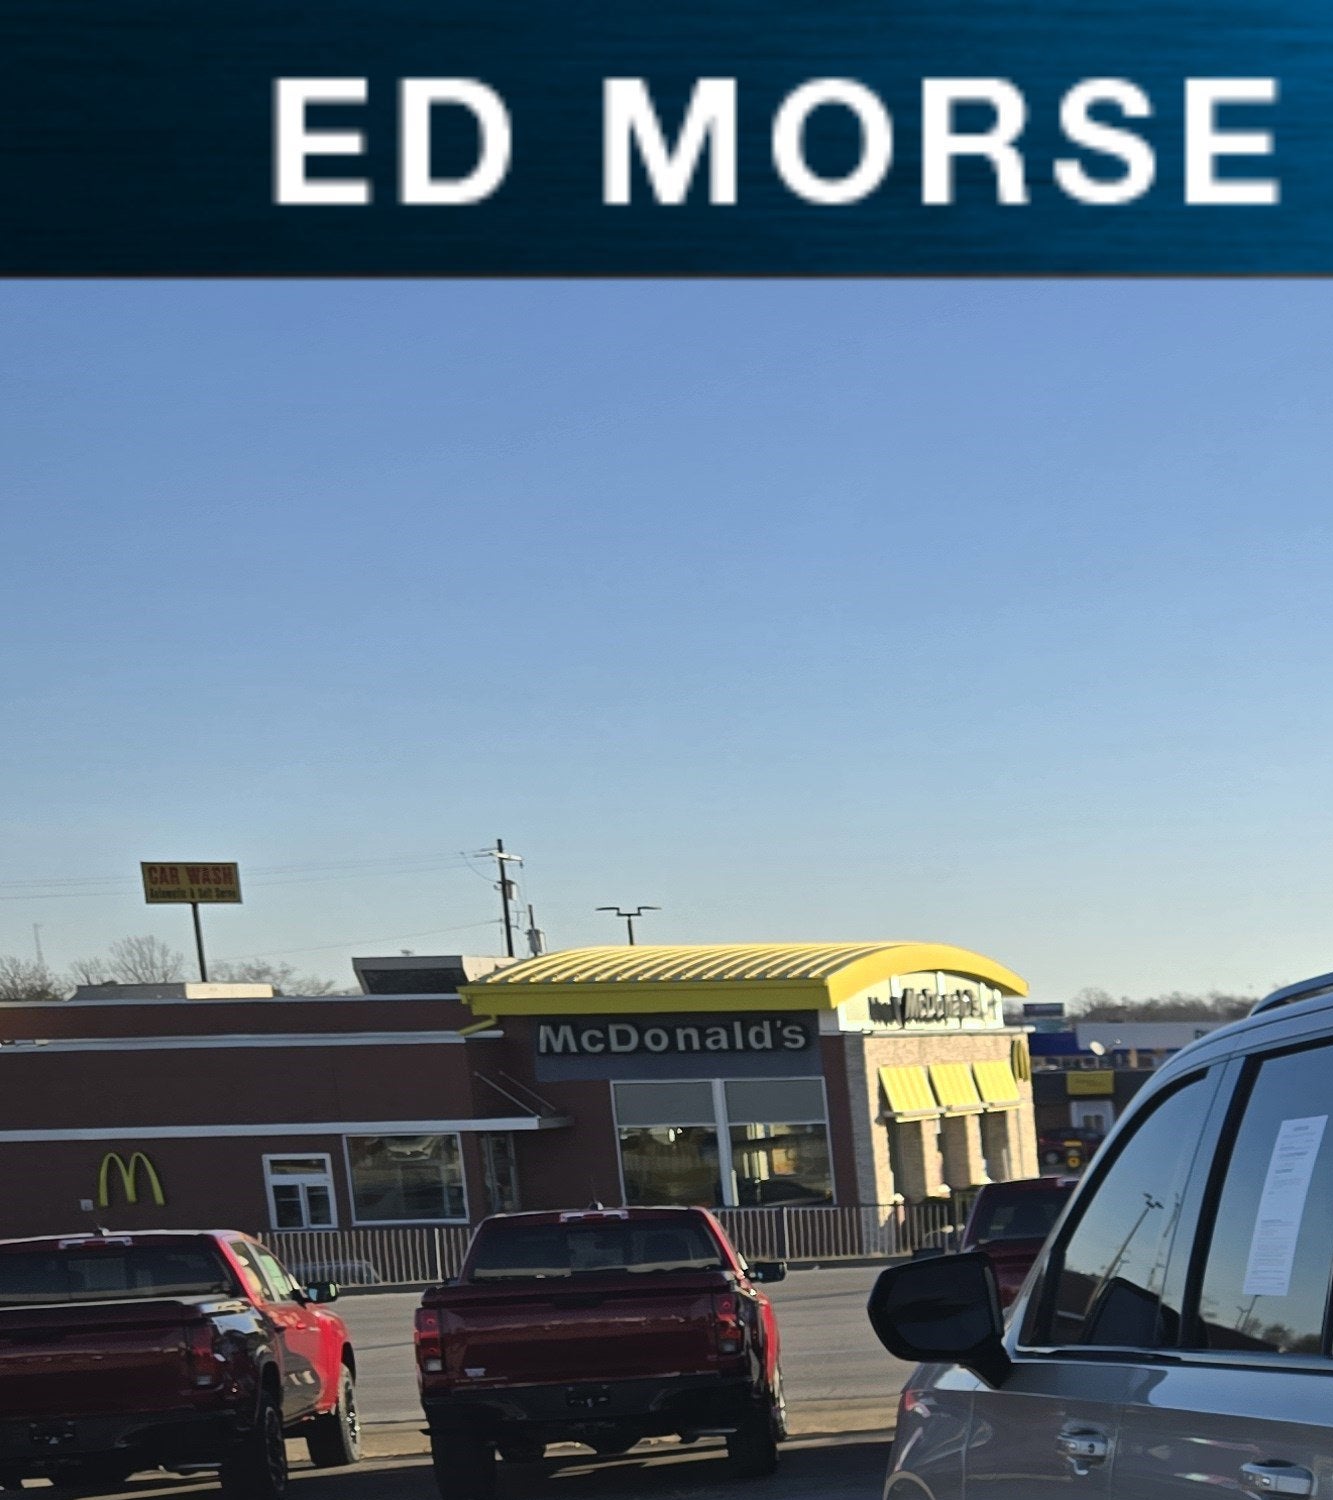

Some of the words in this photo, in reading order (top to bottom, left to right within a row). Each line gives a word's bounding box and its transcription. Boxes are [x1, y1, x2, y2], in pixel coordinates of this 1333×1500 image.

[147, 865, 181, 885] CAR
[185, 865, 235, 885] WASH
[538, 1019, 807, 1054] McDonald's
